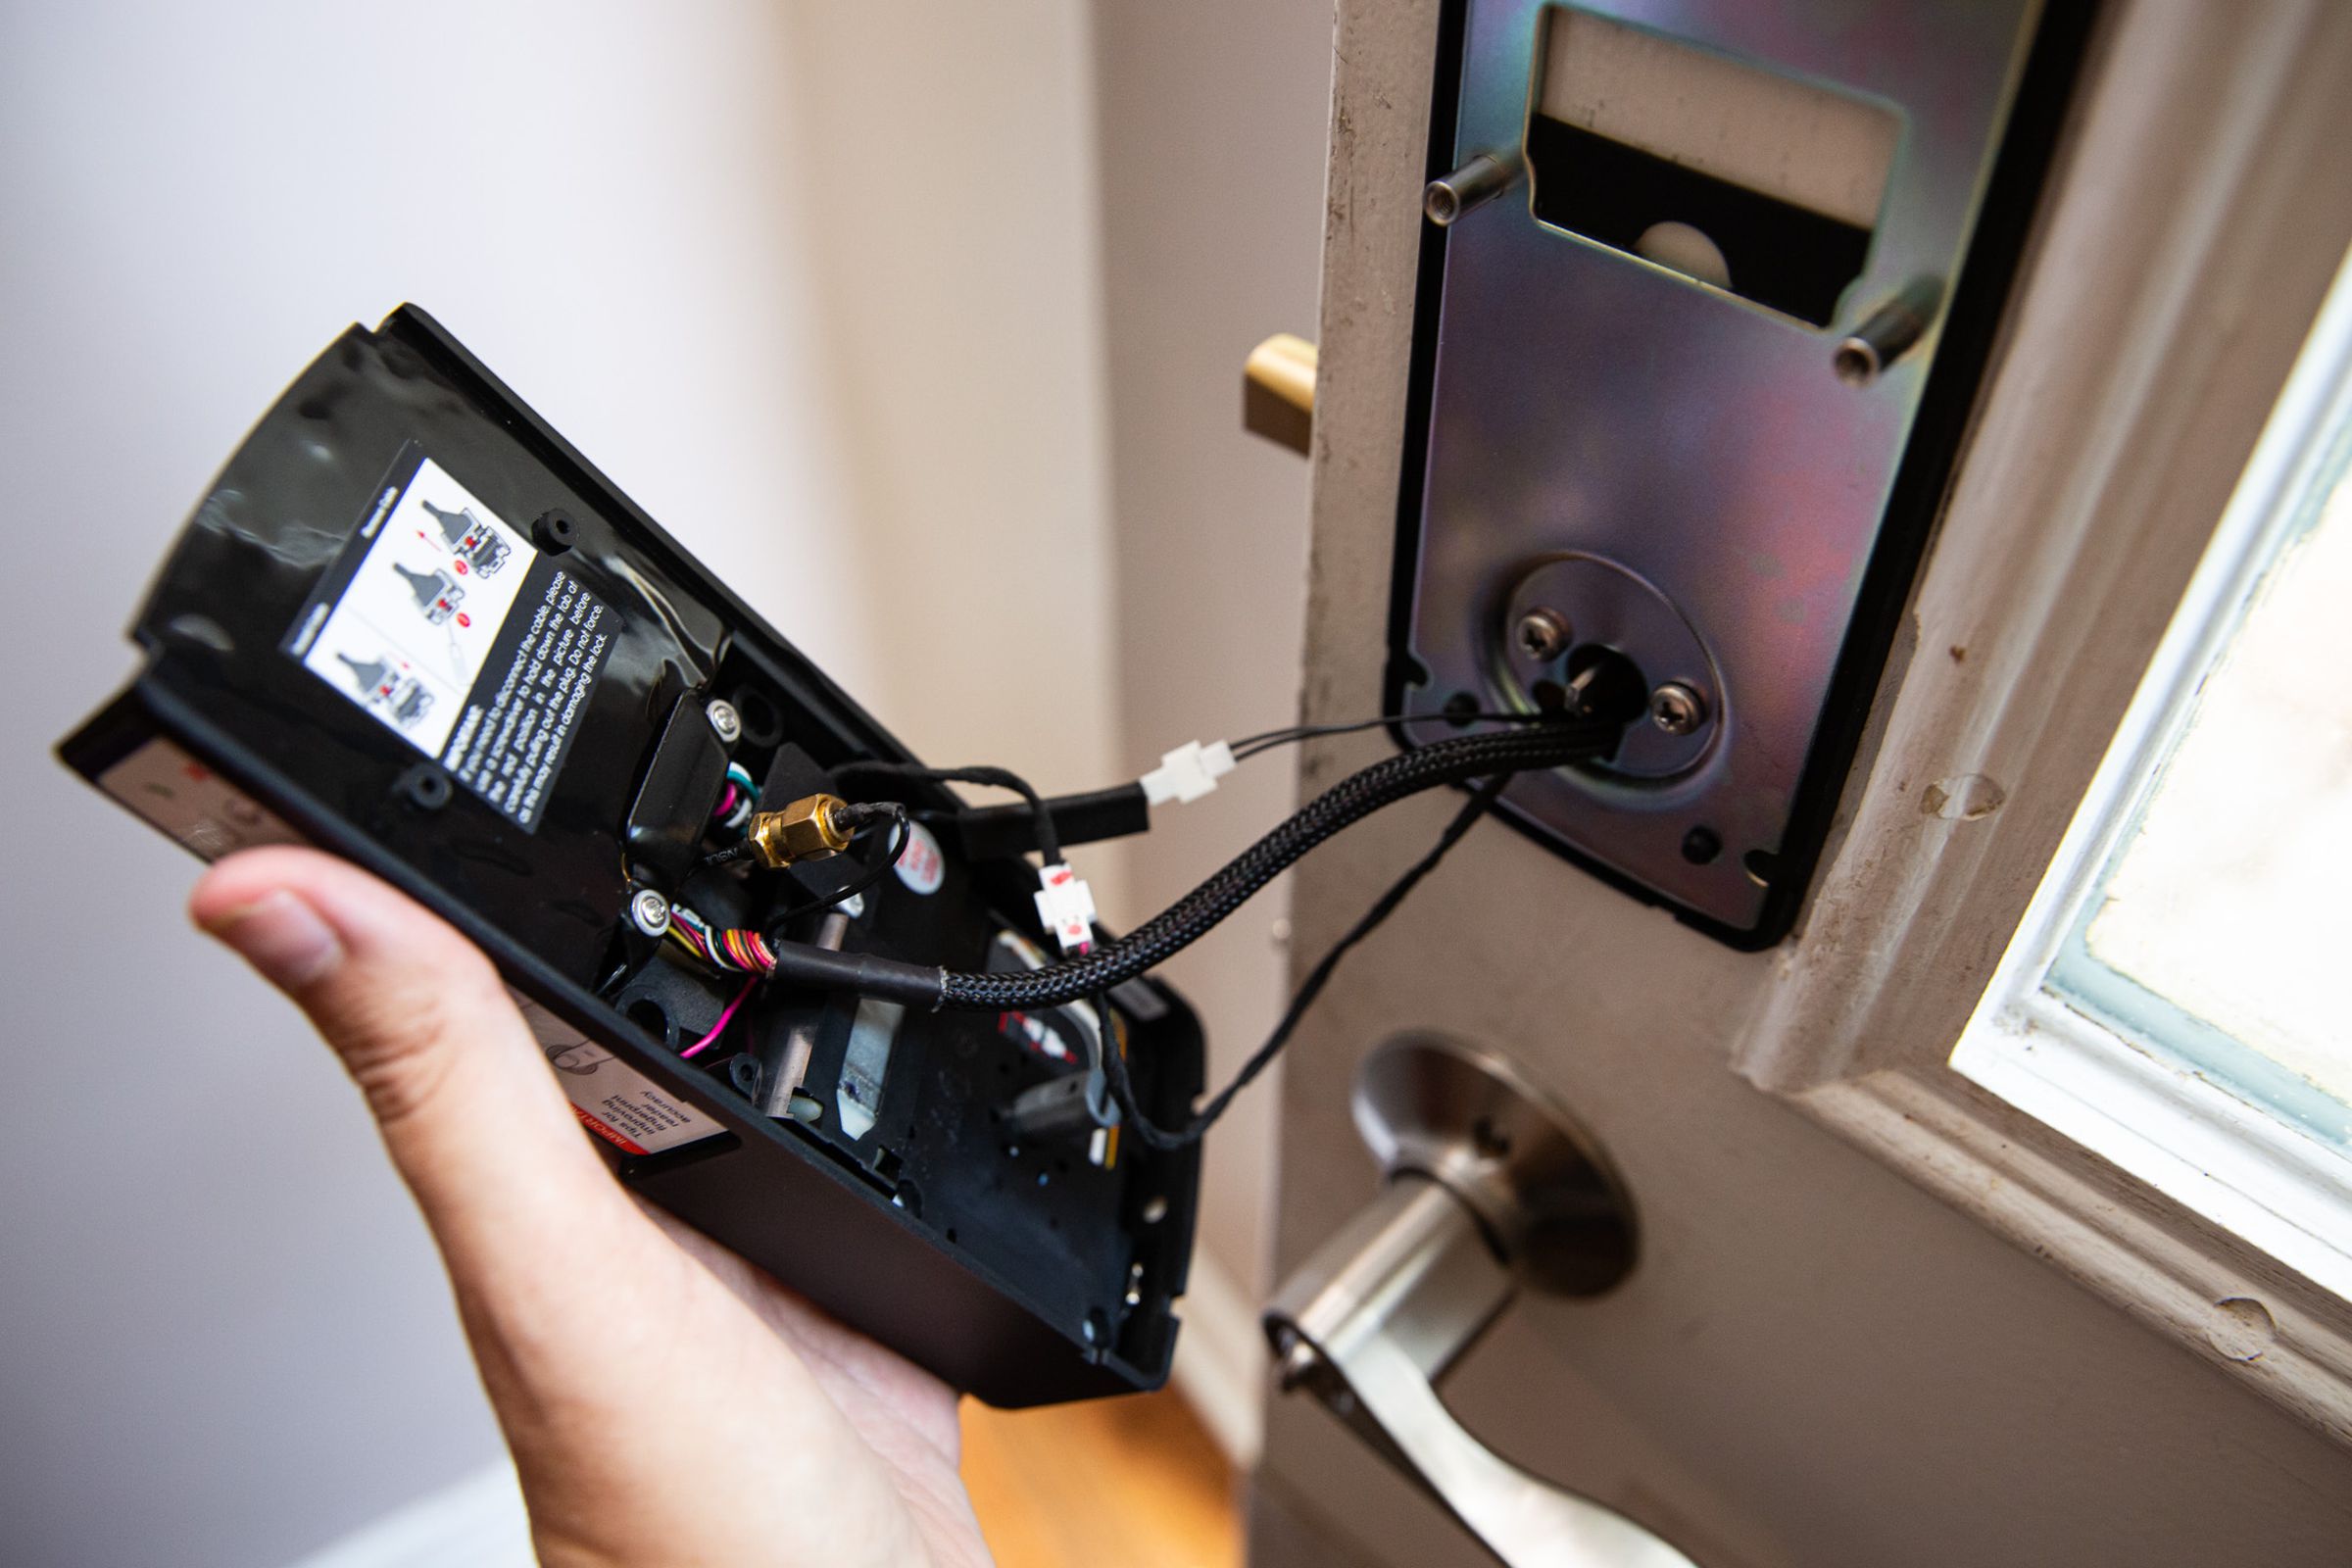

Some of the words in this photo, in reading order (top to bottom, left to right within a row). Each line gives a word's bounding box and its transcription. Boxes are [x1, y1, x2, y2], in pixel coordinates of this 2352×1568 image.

[567, 580, 578, 594] at
[557, 594, 572, 612] tab
[548, 612, 564, 630] the
[487, 706, 502, 720] to
[495, 649, 527, 709] disconnect
[519, 633, 536, 652] the
[545, 570, 565, 606] please
[536, 630, 555, 660] down
[522, 658, 542, 685] hold
[487, 780, 506, 802] the
[501, 753, 517, 776] red
[513, 708, 538, 752] position
[531, 692, 545, 704] in
[540, 668, 556, 687] the
[553, 628, 573, 665] picture
[568, 592, 591, 624] before
[516, 684, 530, 698] to
[524, 728, 549, 766] pulling
[541, 708, 555, 729] out
[548, 691, 564, 710] the
[567, 648, 582, 665] Do
[576, 629, 590, 649] not
[532, 762, 551, 789] may
[543, 733, 562, 764] result
[554, 724, 566, 736] in
[561, 671, 591, 725] damaging
[581, 655, 597, 673] the
[589, 633, 607, 657] lock.
[490, 697, 523, 759] screwdriver
[601, 1111, 618, 1123] for
[601, 1099, 656, 1136] improving
[611, 1095, 667, 1132] fingerprint
[640, 1091, 691, 1124] accuracy
[641, 1103, 680, 1128] reader
[571, 1105, 627, 1145] IMPORTA
[618, 1121, 642, 1138] Tips
